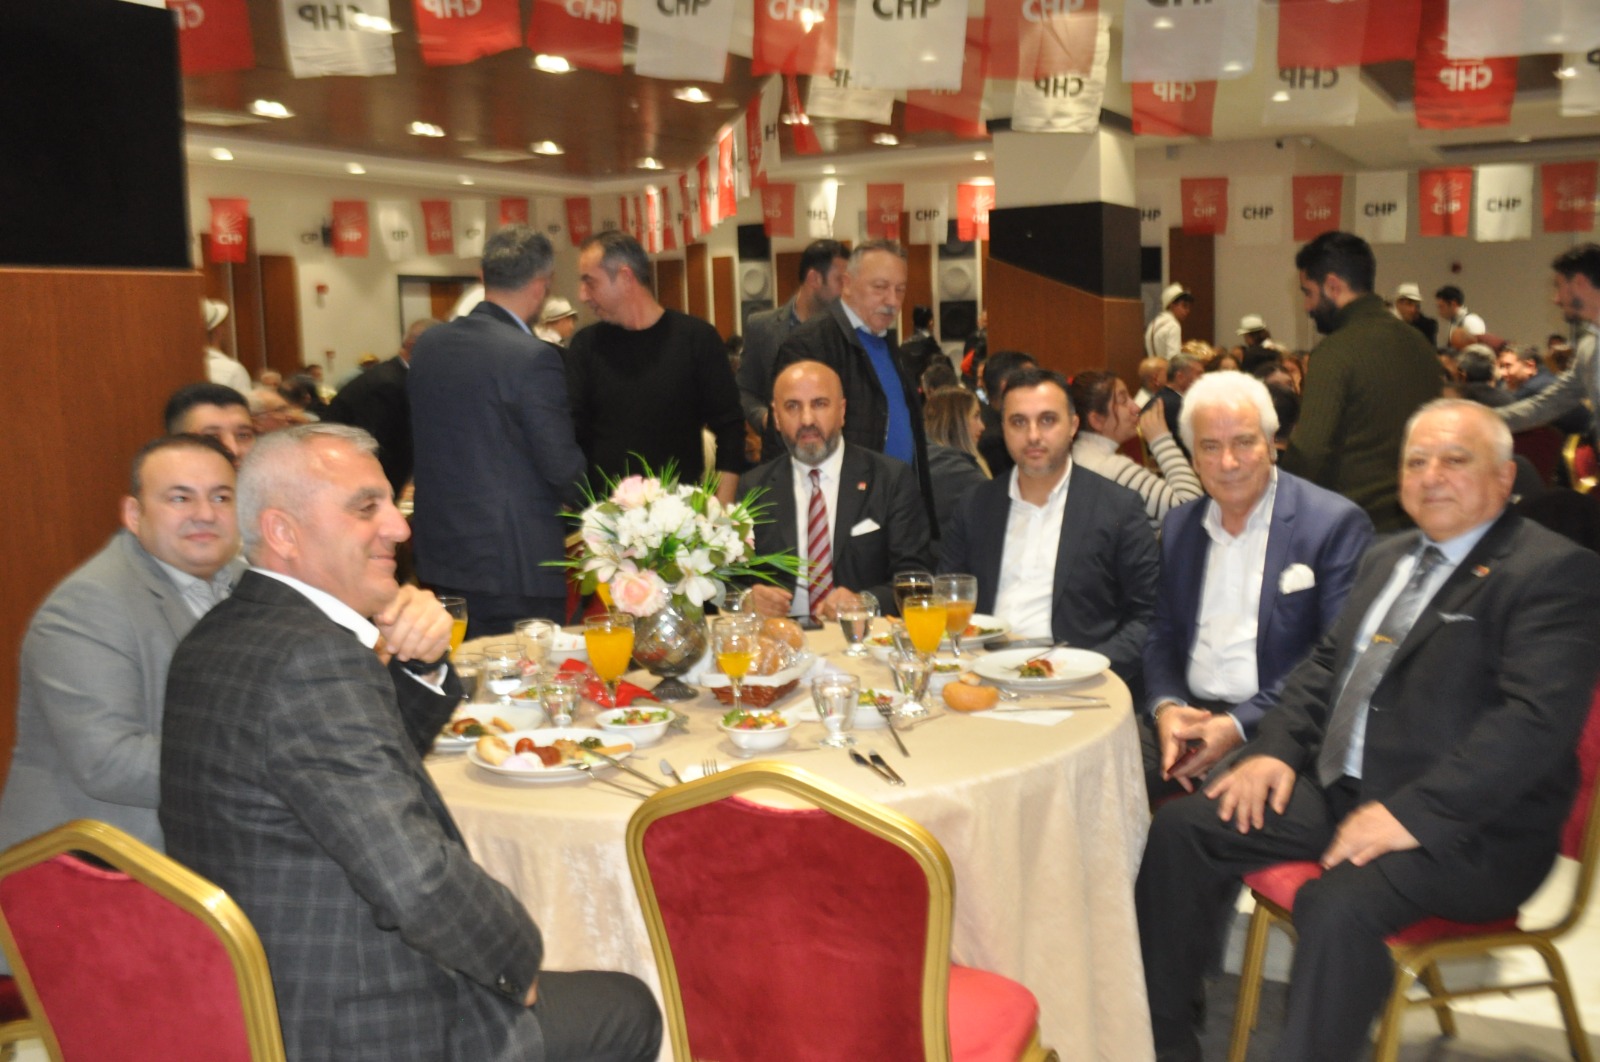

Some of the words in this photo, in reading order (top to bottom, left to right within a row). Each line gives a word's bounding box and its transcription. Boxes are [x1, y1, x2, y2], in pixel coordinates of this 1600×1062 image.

[565, 0, 617, 24] CHP
[872, 0, 942, 21] CHP
[1022, 0, 1084, 24] CHP
[1193, 205, 1217, 218] CHP
[1364, 201, 1398, 217] CHP
[1486, 197, 1522, 213] CHP
[1557, 196, 1587, 212] CHP
[915, 209, 940, 222] CHP
[1140, 208, 1161, 221] HP
[1242, 205, 1274, 220] CHP
[1305, 208, 1332, 221] CHP
